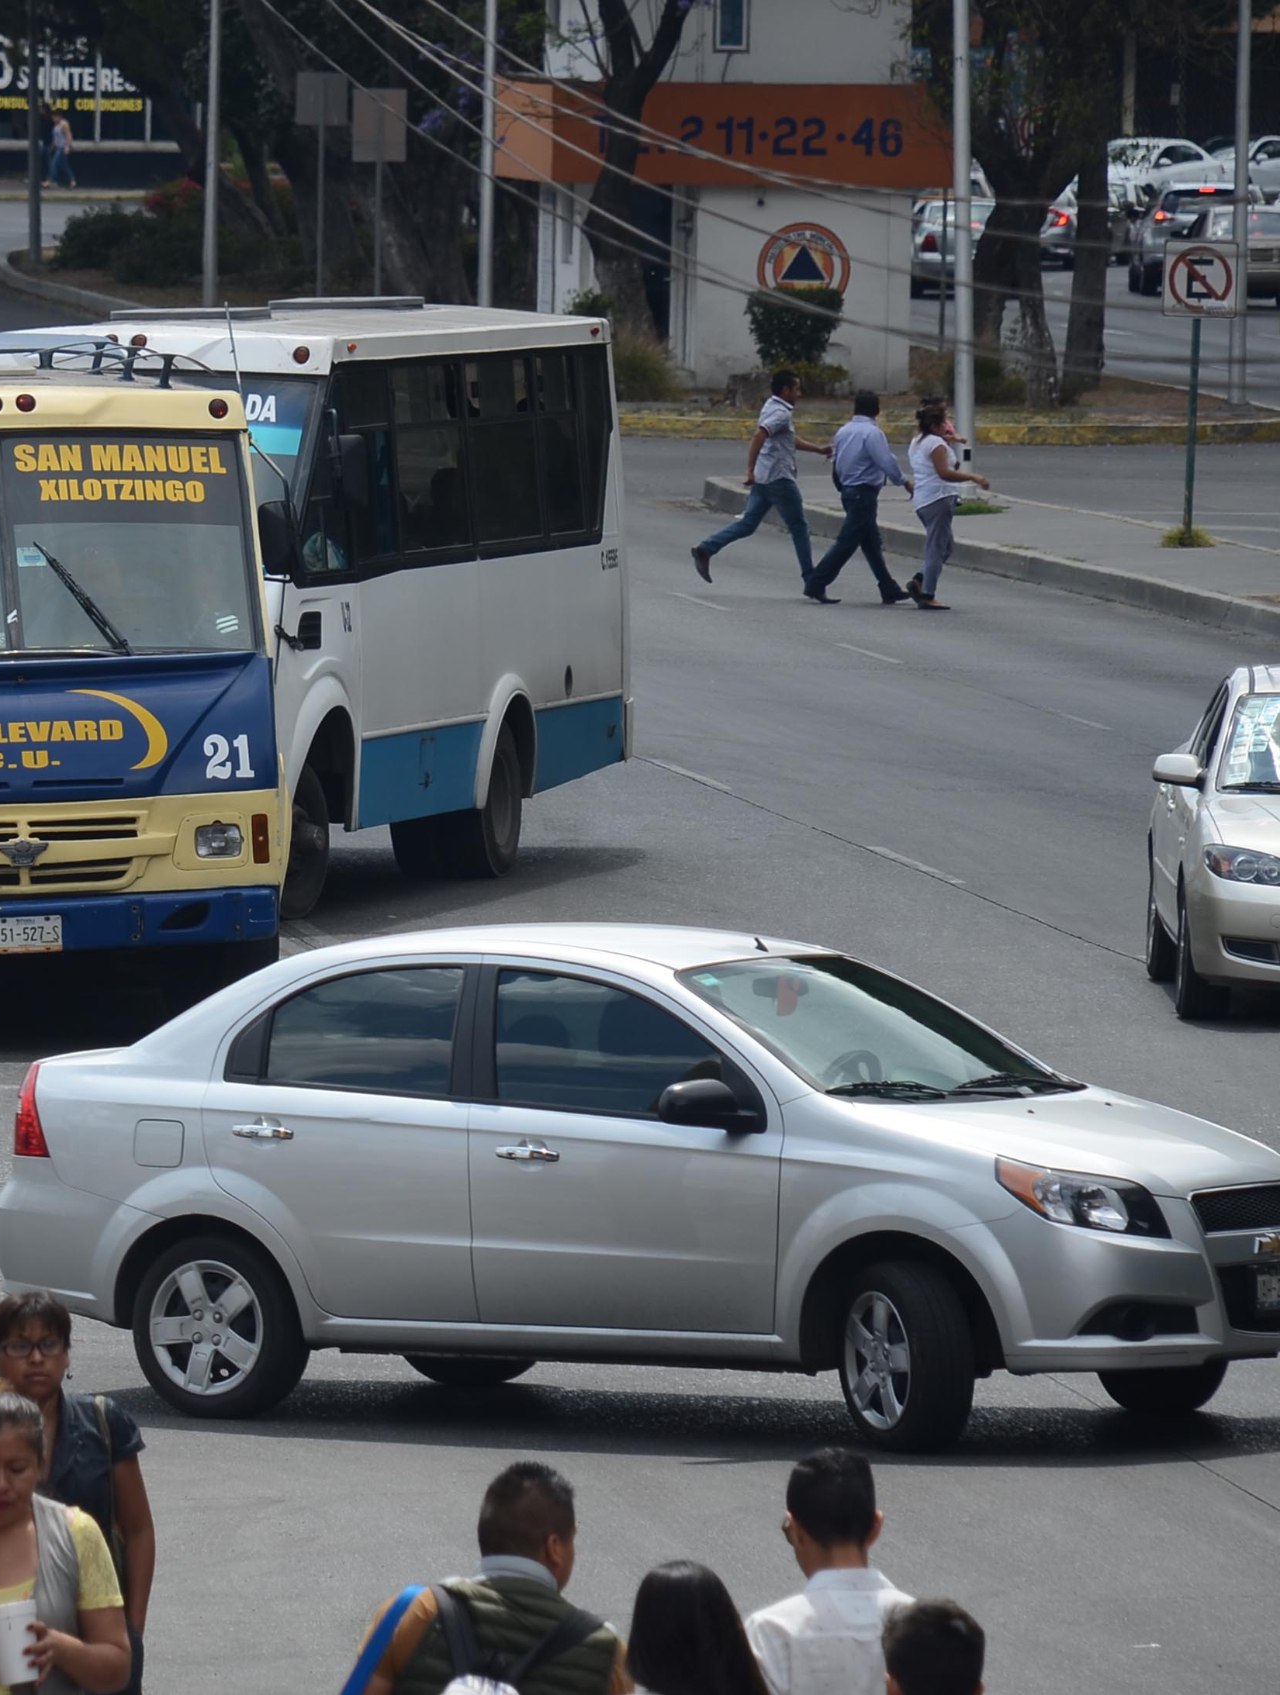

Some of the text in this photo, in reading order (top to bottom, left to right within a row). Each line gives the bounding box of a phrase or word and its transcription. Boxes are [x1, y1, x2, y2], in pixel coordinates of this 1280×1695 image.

[13, 443, 227, 475] SAN MANUEL
[38, 478, 205, 503] XILOTZINGO
[203, 733, 256, 780] 21
